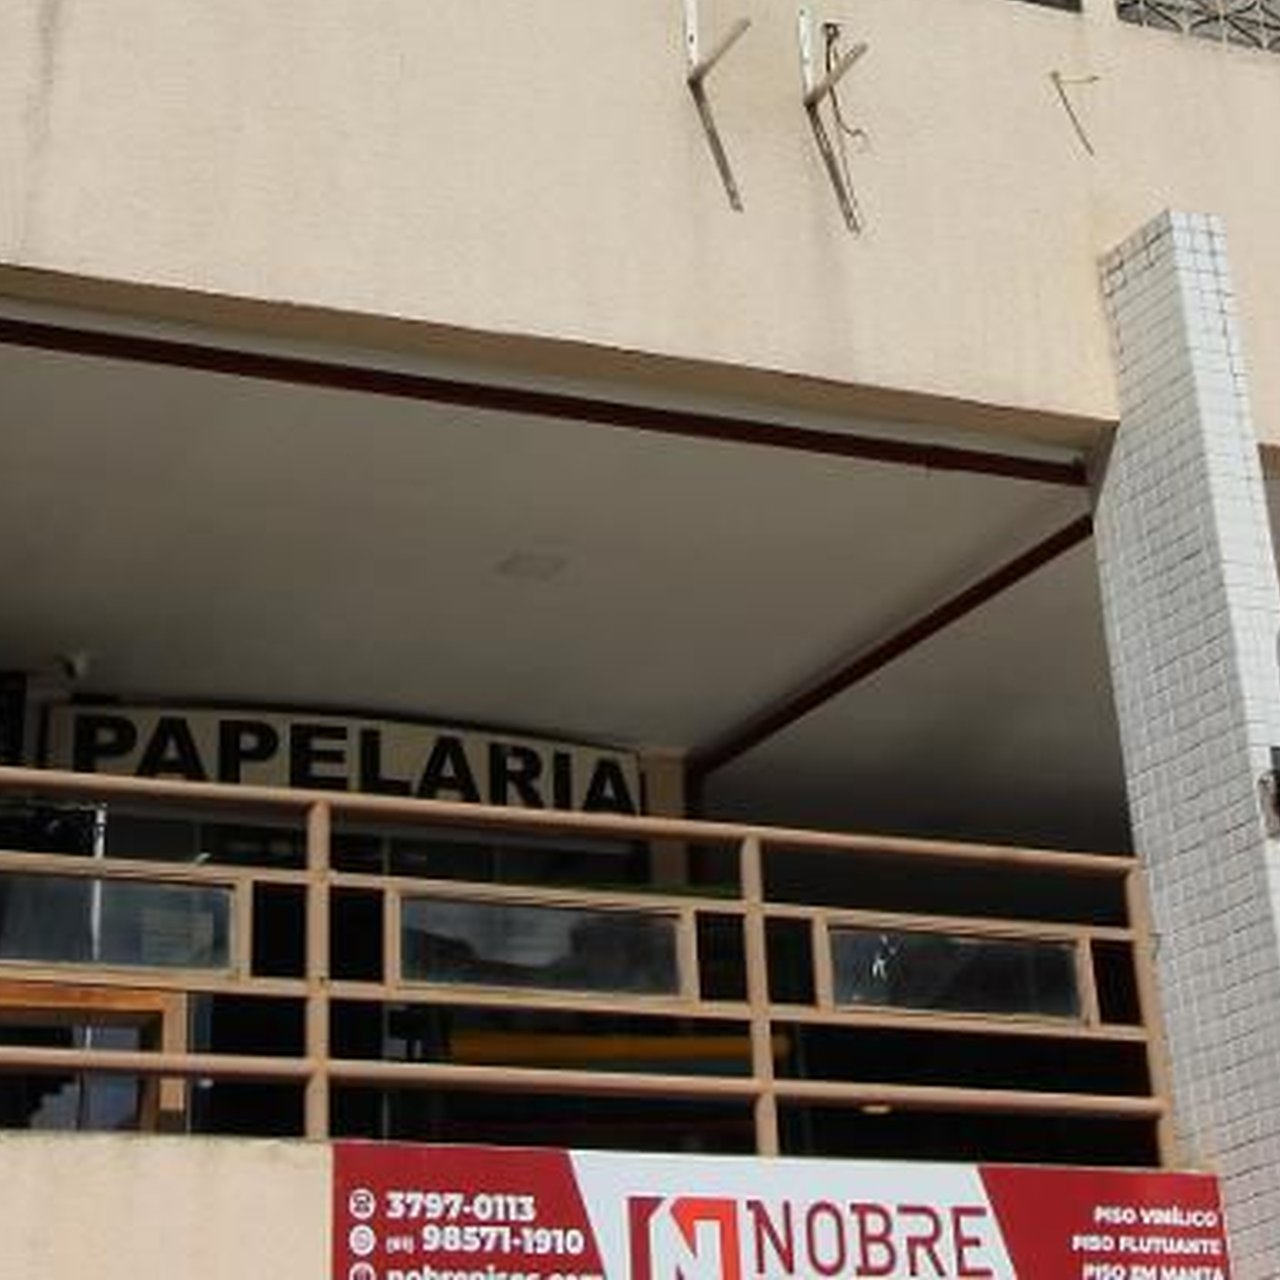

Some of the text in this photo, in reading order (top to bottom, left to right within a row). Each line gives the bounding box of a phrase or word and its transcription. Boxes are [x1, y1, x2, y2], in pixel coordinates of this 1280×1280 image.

[73, 713, 639, 816] PAPELARIA
[385, 1191, 536, 1221] 3797-0113
[1094, 1204, 1219, 1227] PISO VINÍLICO
[422, 1224, 585, 1255] 98571-1910
[745, 1199, 995, 1278] NOBRE
[1072, 1234, 1223, 1255] PISO FLUTUANTE
[1082, 1262, 1226, 1280] PISO EM MANTA
